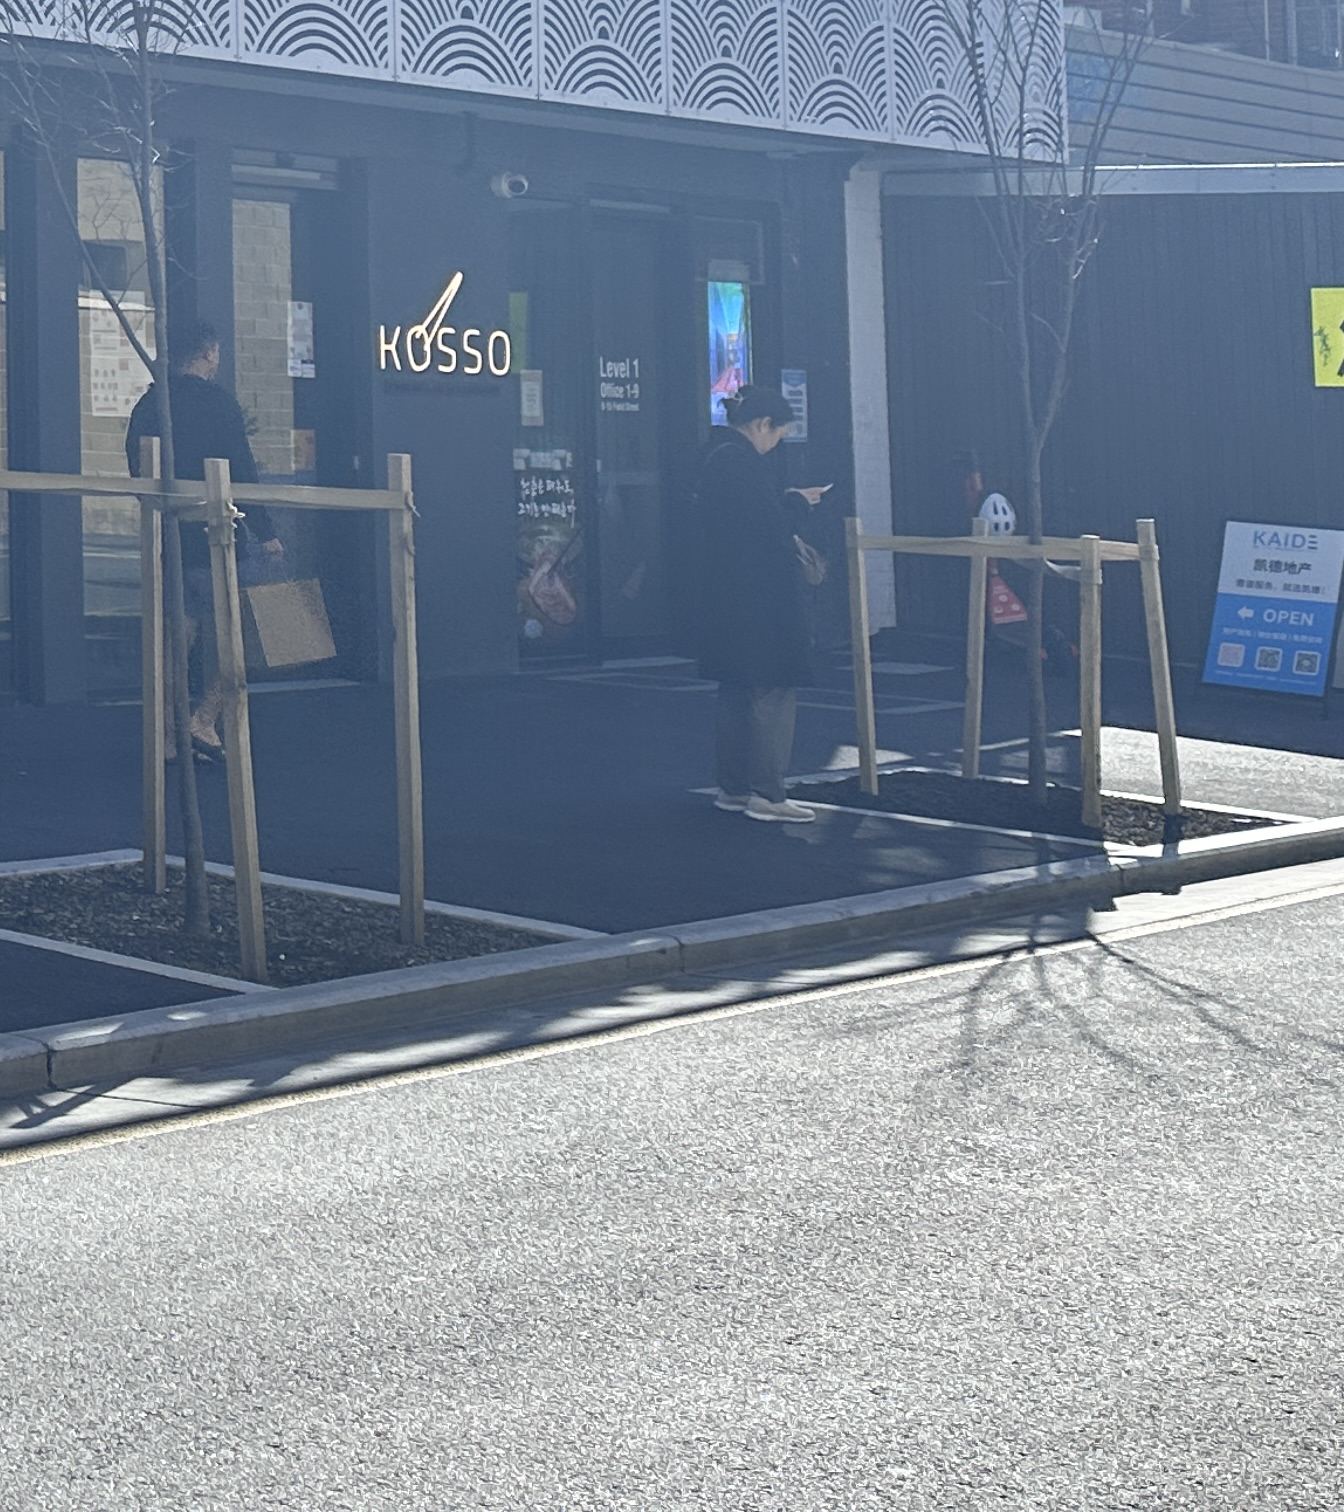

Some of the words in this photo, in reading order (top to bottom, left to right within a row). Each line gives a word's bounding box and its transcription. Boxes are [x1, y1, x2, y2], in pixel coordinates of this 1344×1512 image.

[379, 324, 511, 376] KOSSO
[599, 356, 630, 378] Level
[633, 358, 639, 378] 1
[600, 382, 624, 399] Office
[1253, 531, 1318, 550] KAIDE
[1263, 609, 1314, 626] OPEN
